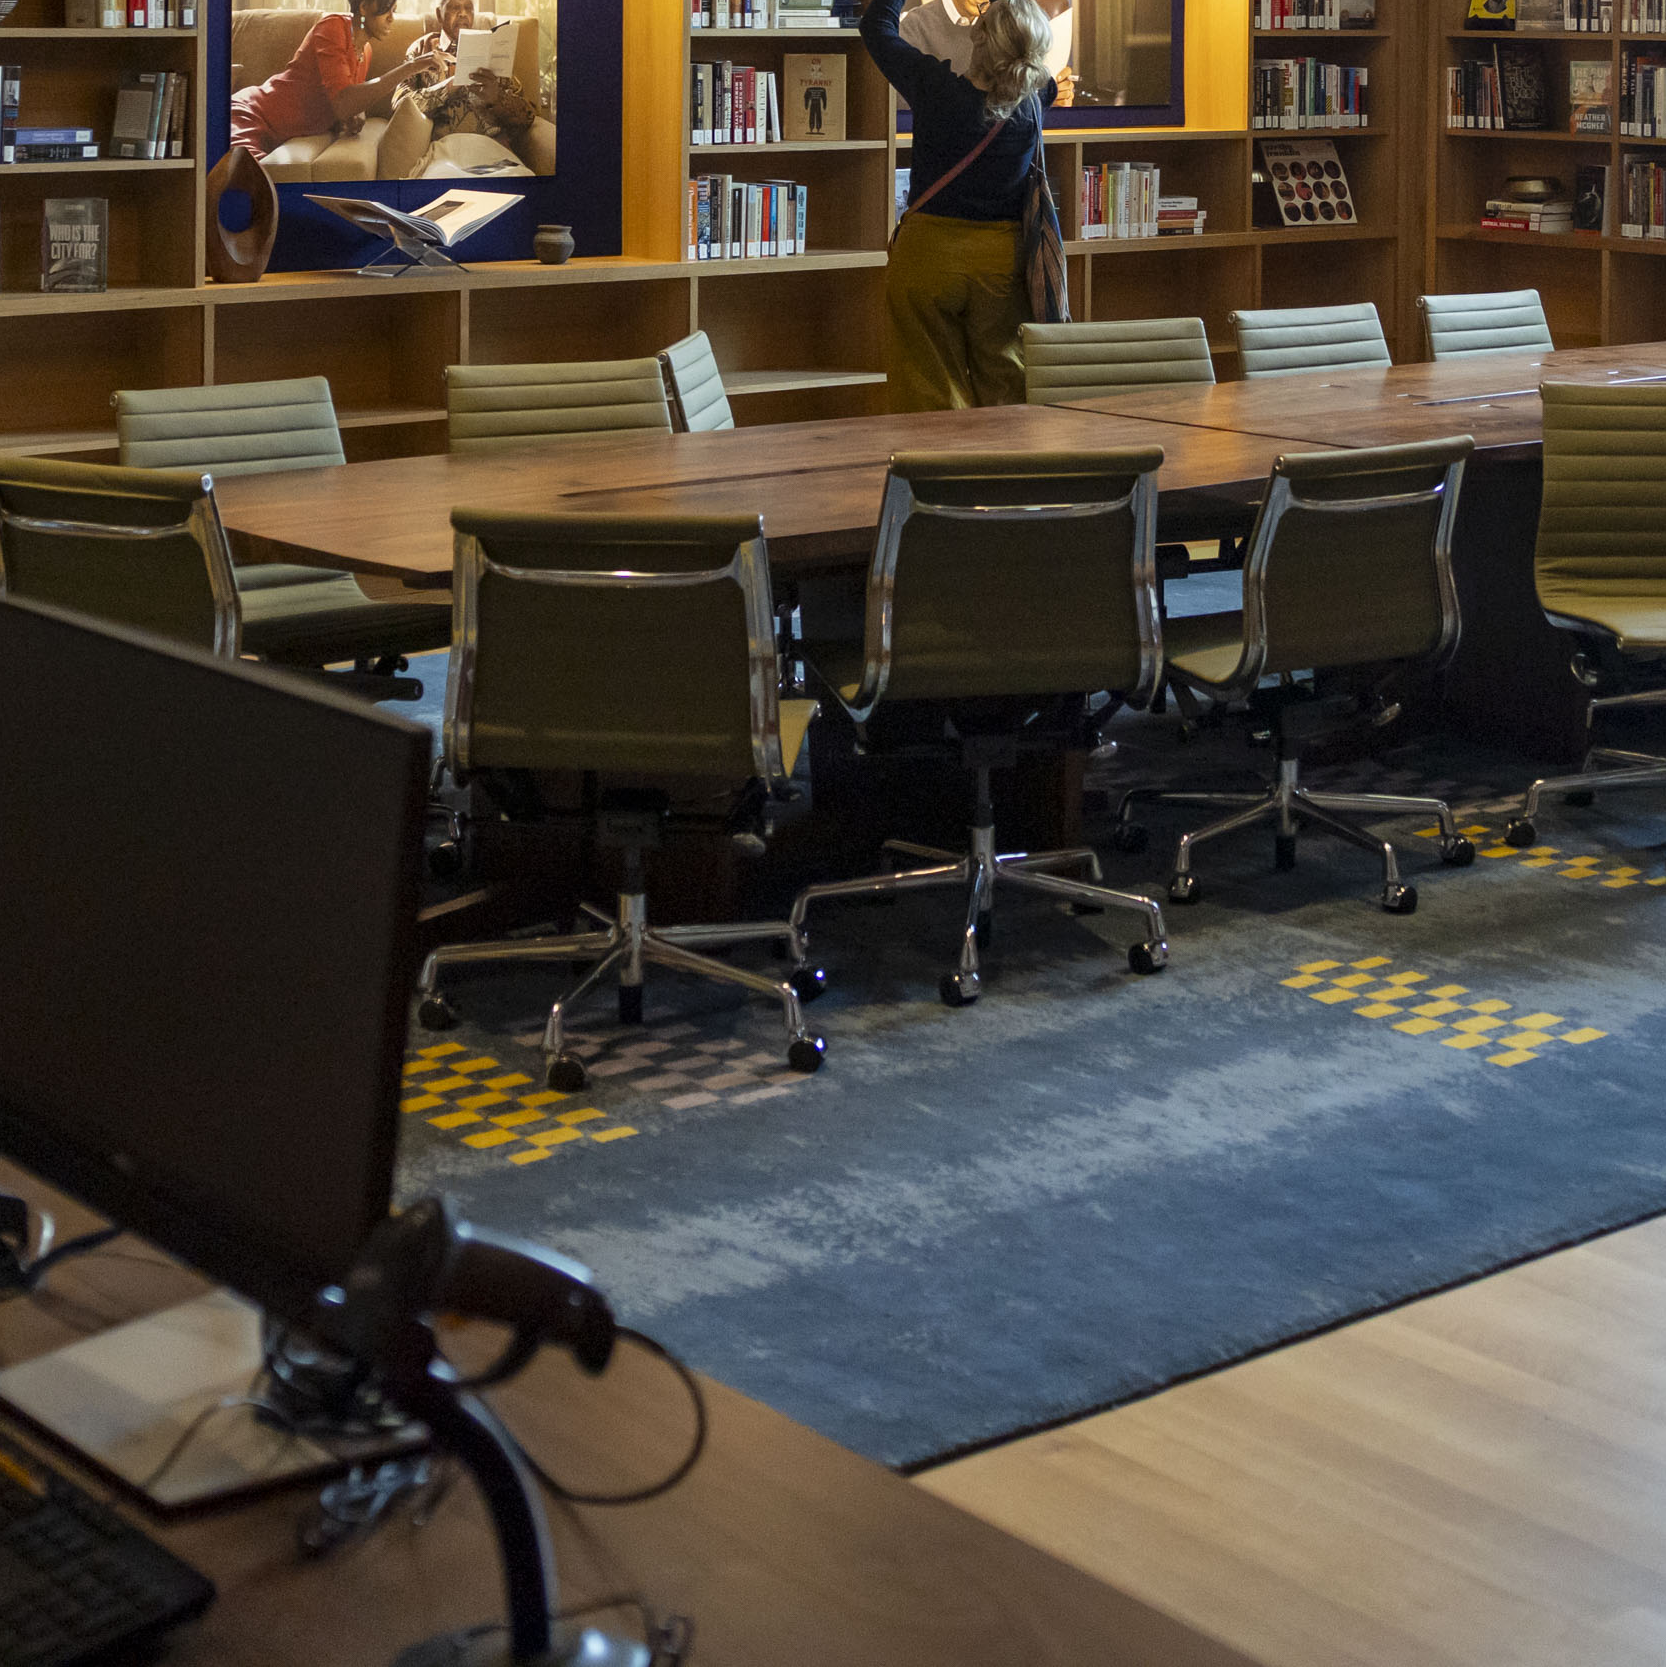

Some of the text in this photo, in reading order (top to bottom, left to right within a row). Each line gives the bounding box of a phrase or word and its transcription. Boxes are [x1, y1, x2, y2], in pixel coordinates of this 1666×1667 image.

[811, 57, 822, 65] ON
[799, 79, 833, 87] TYRANNY
[1574, 113, 1606, 122] HEATHER
[48, 224, 101, 242] WHO IS THE
[50, 241, 97, 260] CITY FOR?
